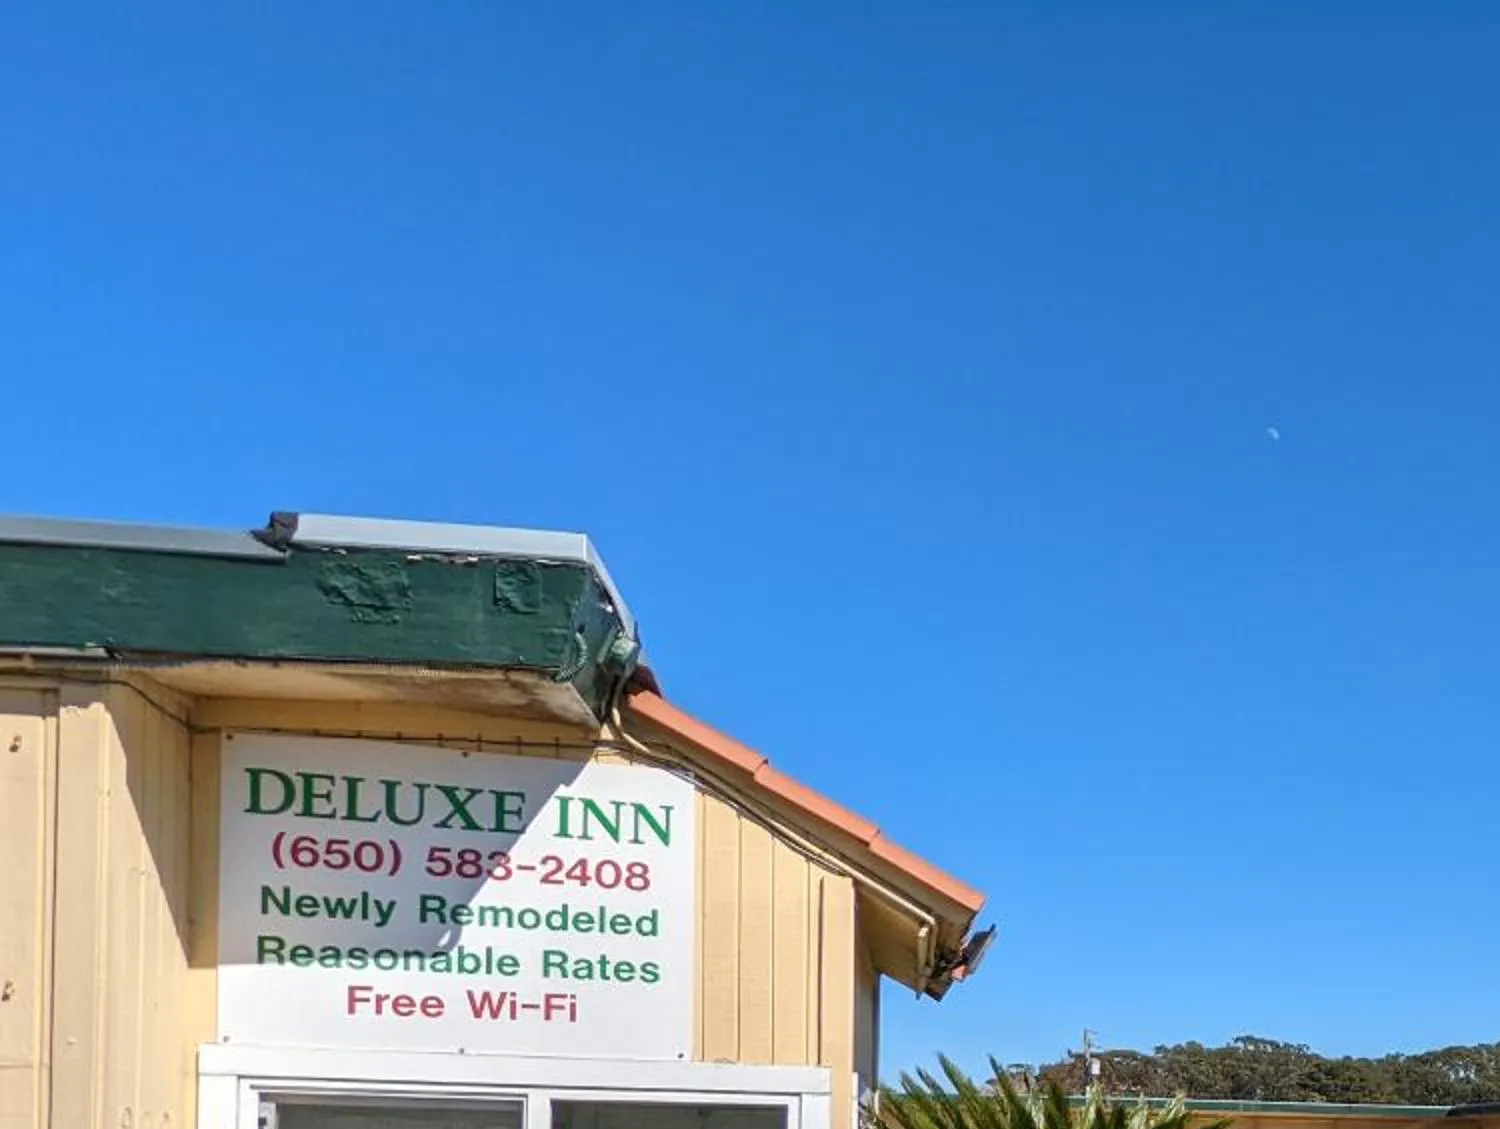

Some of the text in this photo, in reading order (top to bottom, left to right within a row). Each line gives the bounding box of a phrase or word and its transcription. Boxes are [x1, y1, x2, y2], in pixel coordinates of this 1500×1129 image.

[243, 767, 675, 848] DELUXE INN
[271, 831, 652, 892] (650) 583-2408
[260, 886, 660, 937] Newly Remodeled
[256, 934, 662, 984] Reasonable Rates
[346, 985, 579, 1023] Free Wi-Fi
